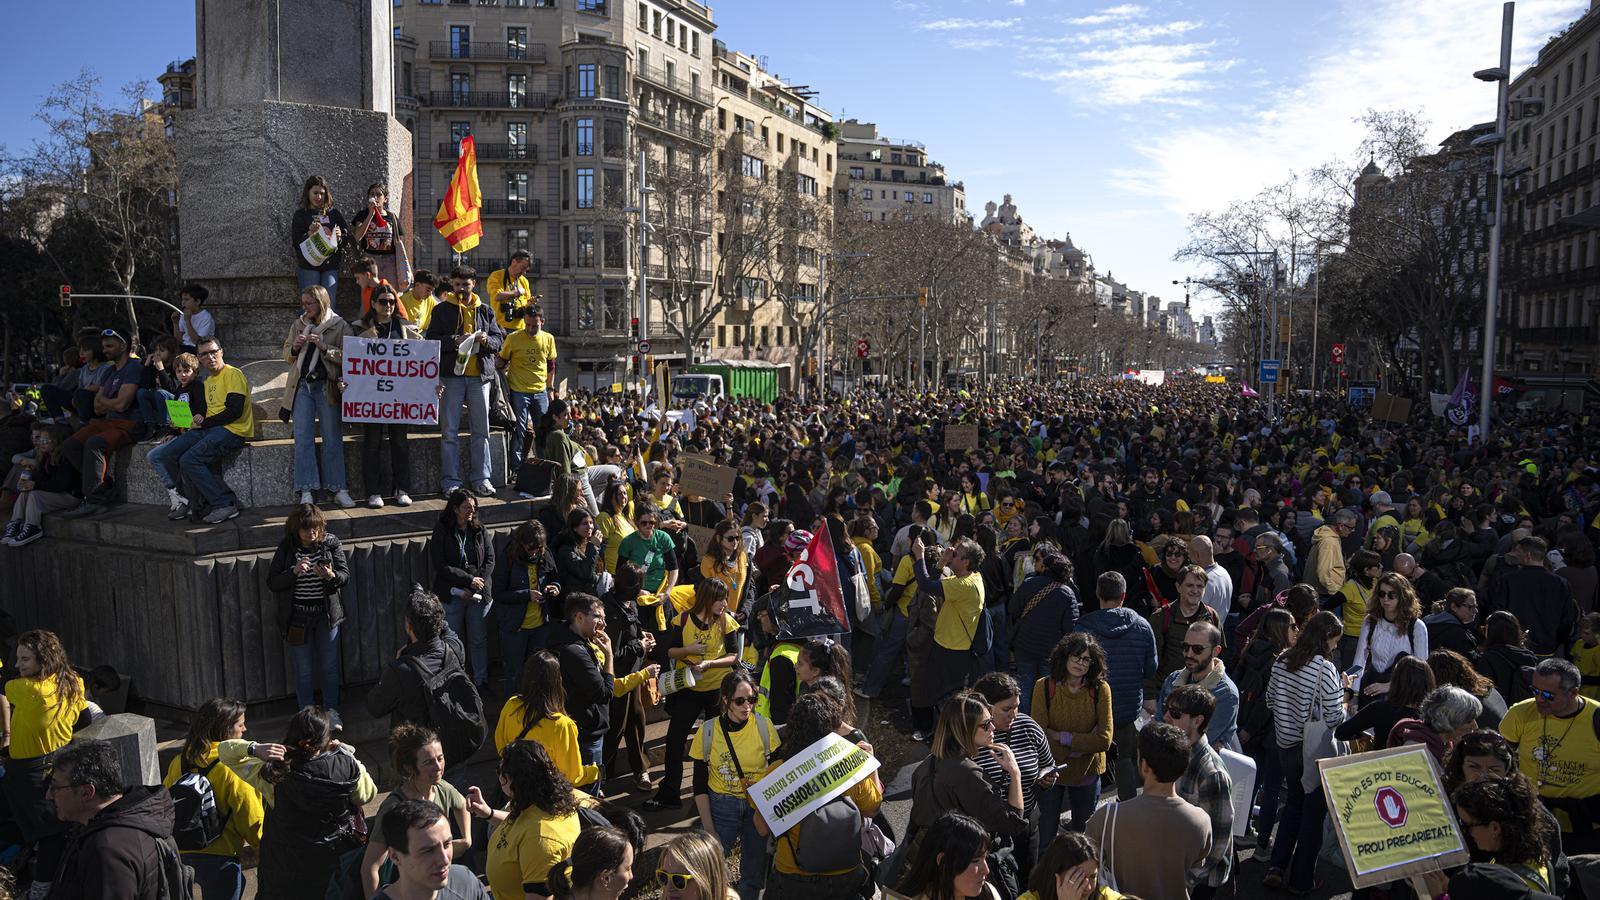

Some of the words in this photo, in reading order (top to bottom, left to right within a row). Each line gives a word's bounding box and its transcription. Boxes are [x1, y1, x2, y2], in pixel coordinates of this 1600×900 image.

[367, 342, 387, 356] NO
[392, 341, 411, 357] ÉS
[377, 377, 394, 392] ÉS
[785, 768, 799, 785] LES
[799, 759, 818, 778] AVALL
[818, 772, 833, 789] LA
[1351, 786, 1362, 804] NO
[1361, 776, 1373, 791] ES
[1374, 771, 1392, 783] POT
[1395, 772, 1436, 798] EDUCAR
[773, 780, 821, 822] PROFESSIÓ
[1357, 840, 1385, 857] PROU
[1387, 823, 1453, 850] PRECARIETAT!
